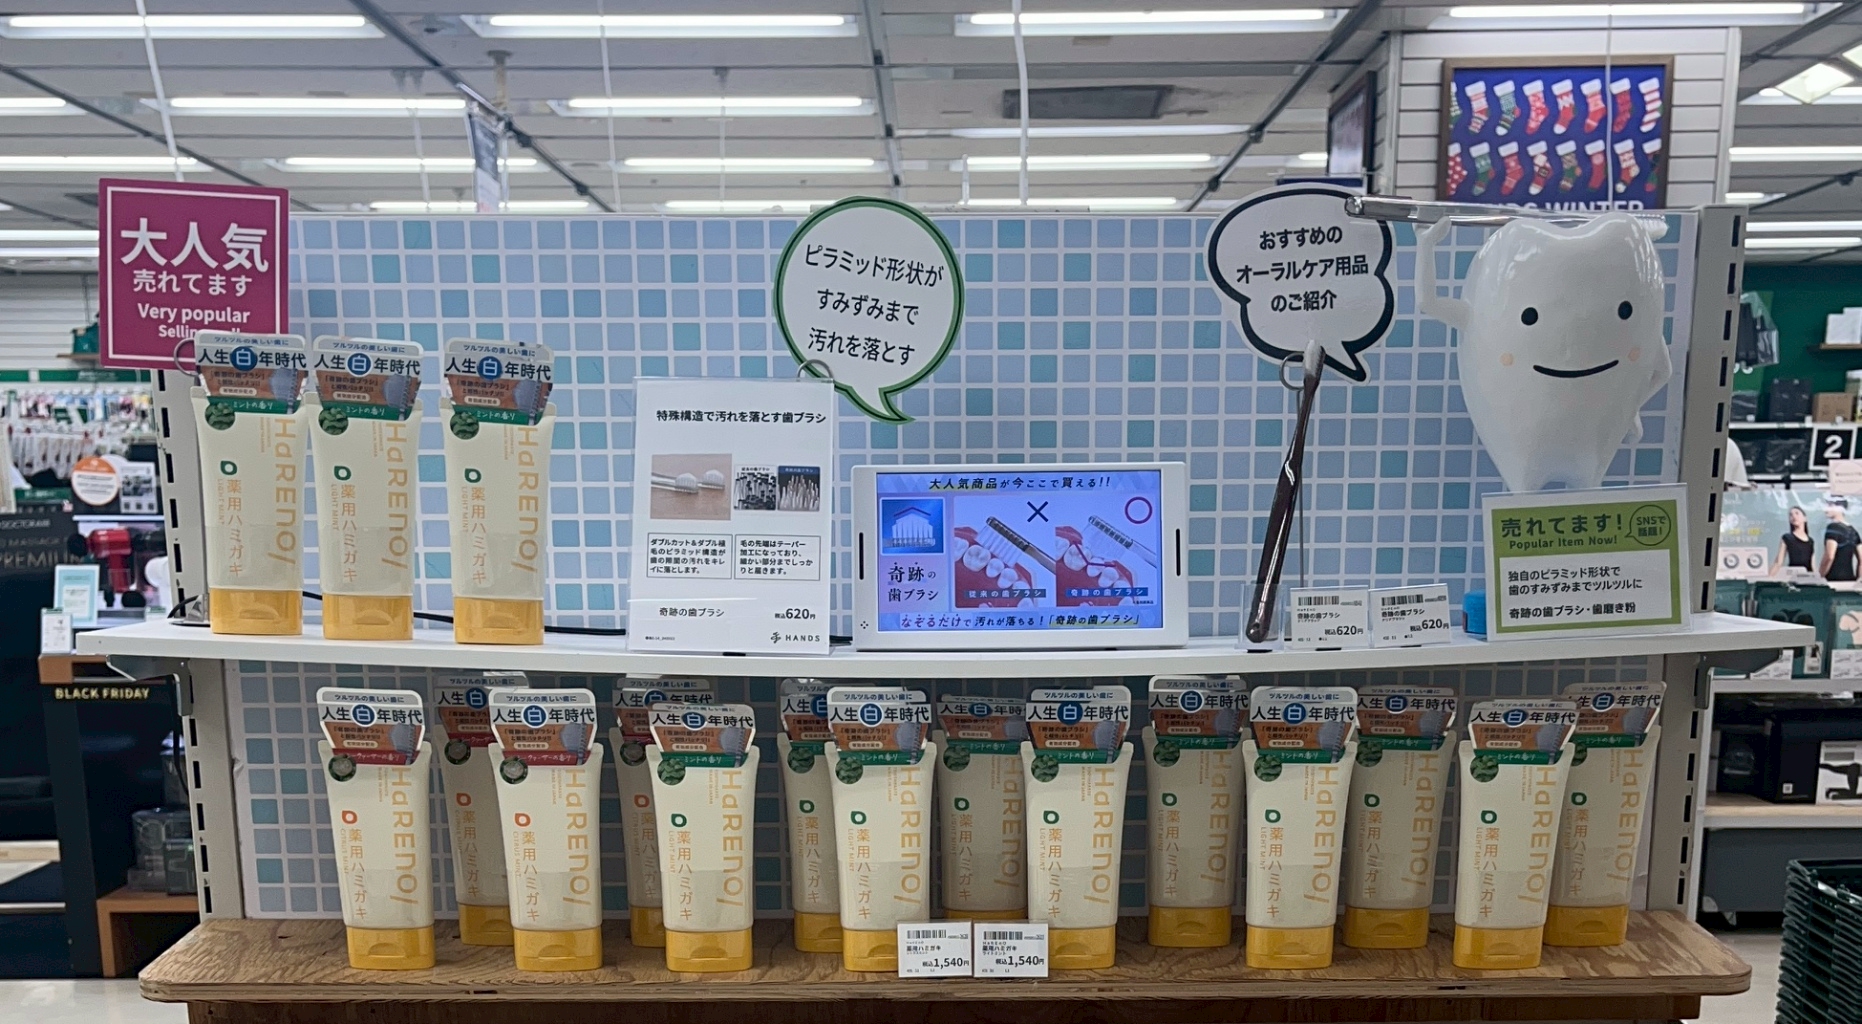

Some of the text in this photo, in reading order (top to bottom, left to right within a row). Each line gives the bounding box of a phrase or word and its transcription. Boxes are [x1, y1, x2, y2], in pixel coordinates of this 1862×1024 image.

[120, 217, 269, 273] 大人気
[1259, 226, 1343, 250] おすすめの
[805, 244, 944, 287] ピラミッド形状が
[1236, 254, 1369, 284] オーラルケア用品
[133, 269, 252, 297] 売れてます
[817, 288, 919, 326] すみずみまで
[1271, 289, 1337, 313] のご紹介
[137, 303, 250, 325] Very popular
[158, 325, 198, 339] Sellin
[808, 327, 915, 365] 汚れを落とす
[198, 347, 307, 369] 人生白年時代
[314, 355, 421, 375] 人生白年時代
[445, 356, 551, 381] 人生白年時代
[656, 410, 827, 424] 特殊構造で汚れを落とす歯ブラシ
[1824, 435, 1843, 458] 2
[227, 479, 243, 577] 薬用ハミガキ
[1501, 514, 1622, 538] 売れてます!
[1636, 516, 1667, 526] SNSで
[341, 484, 357, 582] 薬用ハミガキ
[471, 486, 487, 585] 薬用ハミガキ
[1509, 535, 1618, 551] Popular Item Now!
[887, 565, 936, 583] 奇跡の
[1508, 566, 1621, 582] 独自のピラミッド形状で
[887, 588, 939, 602] 歯ブラシ
[968, 589, 1042, 598] 従来の歯ブラシ
[1070, 588, 1143, 597] 奇跡の歯ブラシ
[1508, 579, 1643, 596] 歯のすみずみまでツルツルに
[659, 607, 725, 617] 奇跡の歯ブラシ
[1509, 602, 1636, 620] 奇跡の歯ブラシ・歯磨き粉
[1324, 625, 1364, 636] 税込620円
[1410, 618, 1449, 632] 税込620円
[785, 634, 821, 642] HANDS
[55, 687, 150, 700] BLACK FRIDAY
[1151, 692, 1249, 710] 人生白年時代
[322, 706, 422, 724] 人生白年時代
[492, 707, 596, 724] 人生白年時代
[652, 713, 753, 728] 人生白年時代
[829, 705, 930, 722] 人生白年時代
[1028, 704, 1129, 721] 人生白年時代
[1251, 704, 1355, 721] 人生白年時代
[1471, 709, 1576, 725] 人生白年時代
[958, 814, 973, 900] 薬用ハミガキ
[1165, 810, 1180, 897] 薬用ハミガキ
[1569, 809, 1589, 897] 薬用ハミガキ
[349, 829, 367, 920] 薬用ハミガキ
[521, 831, 540, 921] 薬用ハミガキ
[677, 830, 693, 921] 薬用ハミガキ
[856, 828, 871, 920] 薬用ハミガキ
[1048, 828, 1063, 919] 薬用ハミガキ
[1267, 827, 1284, 919] 薬用ハミガキ
[1479, 828, 1500, 919] 薬用ハミガキ
[922, 957, 970, 969] 税込1,540円
[995, 956, 1045, 967] 税込1,540円
